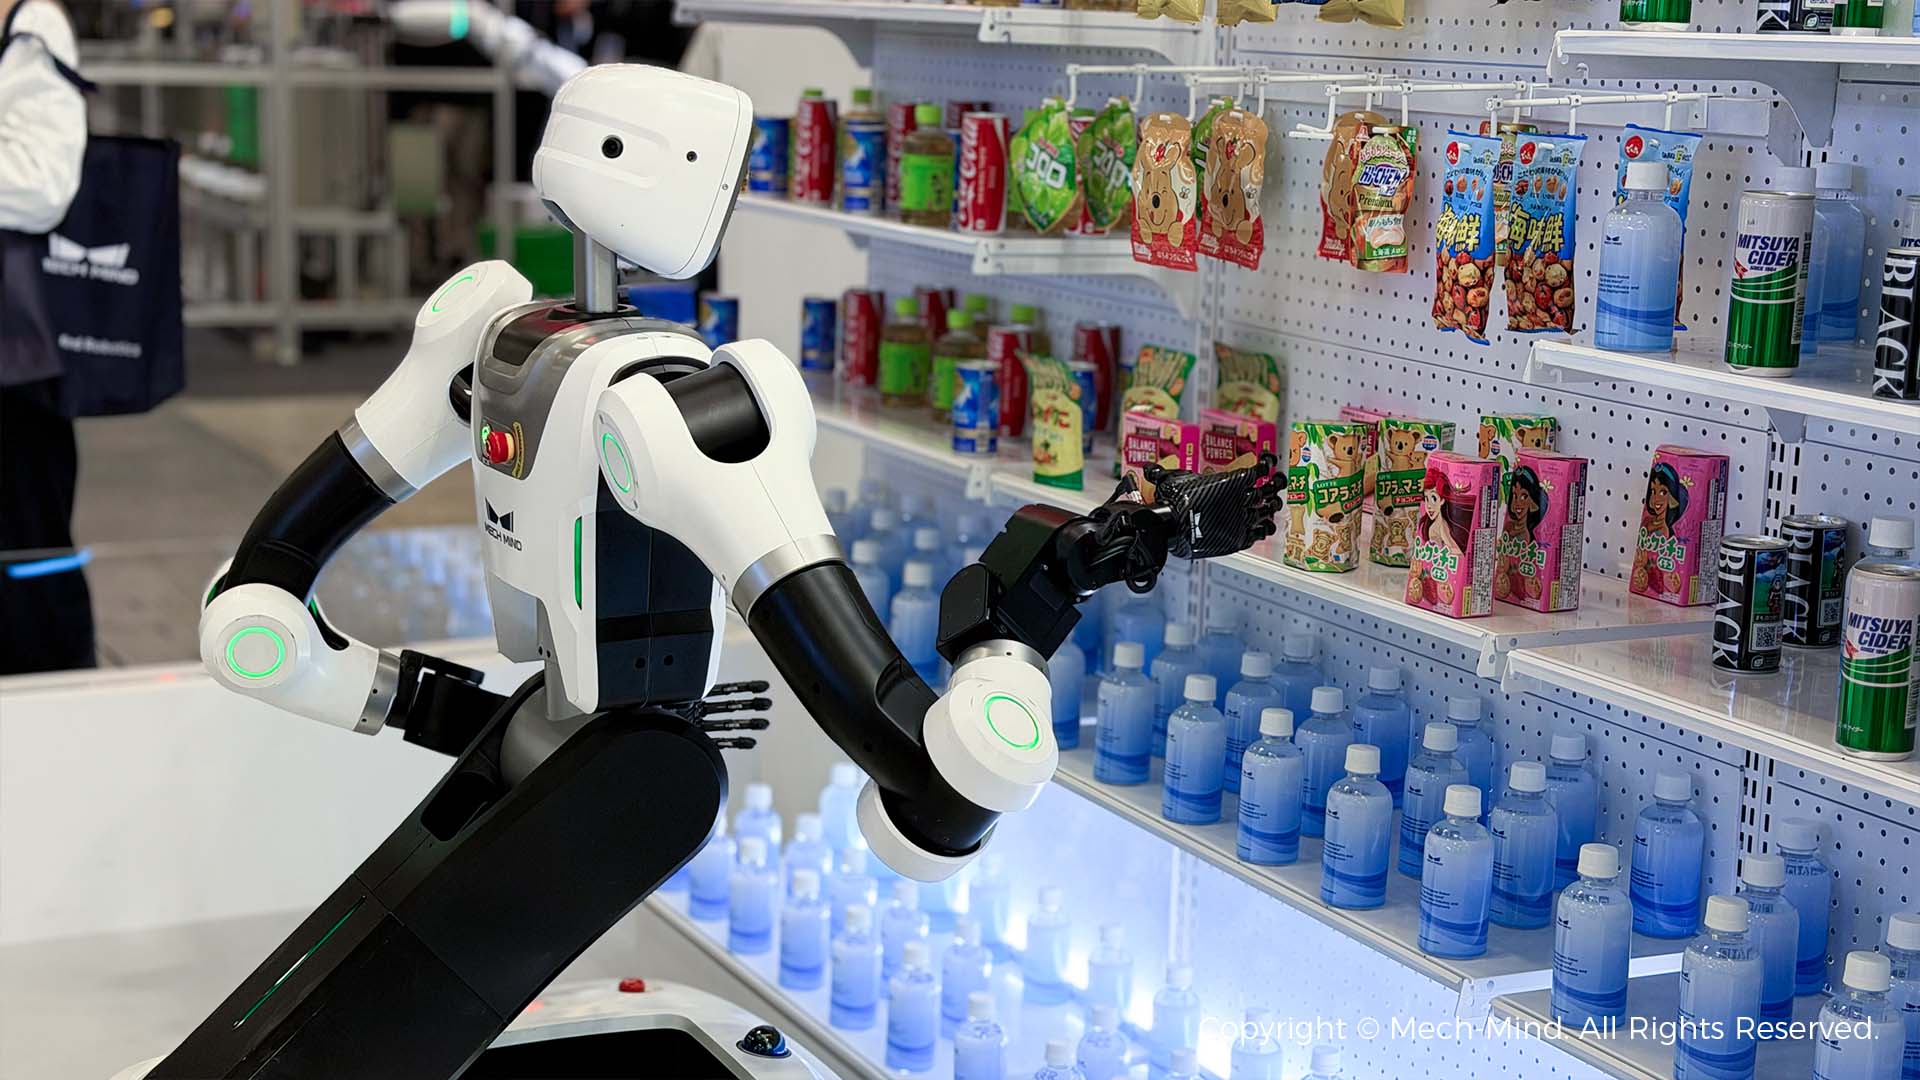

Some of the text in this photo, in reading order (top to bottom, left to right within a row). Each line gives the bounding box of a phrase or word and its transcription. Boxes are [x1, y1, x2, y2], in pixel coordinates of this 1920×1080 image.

[1359, 165, 1403, 187] HI-CHEW
[1737, 234, 1799, 252] MITSUYA
[1748, 250, 1798, 267] CIDER
[1873, 255, 1917, 398] BLACK
[484, 521, 523, 552] MECH MIND
[1413, 537, 1458, 575] パックンチョ
[1782, 527, 1815, 645] BLACK
[1712, 548, 1746, 669] BLACK
[1848, 612, 1912, 636] MITSUYA
[1858, 632, 1911, 651] CIDER
